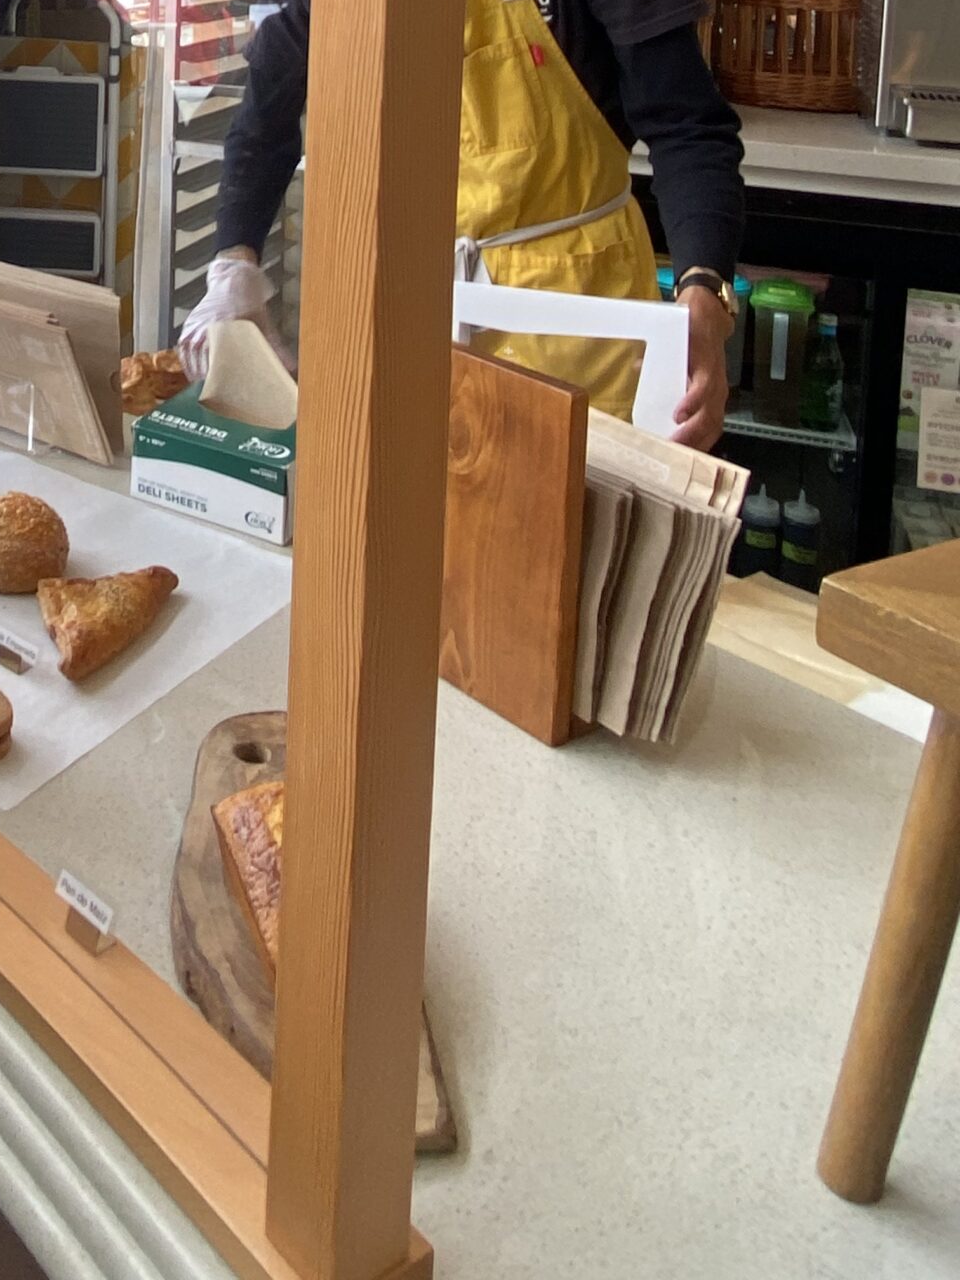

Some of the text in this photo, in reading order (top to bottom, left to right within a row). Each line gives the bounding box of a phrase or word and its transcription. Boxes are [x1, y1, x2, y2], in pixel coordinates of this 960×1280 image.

[906, 334, 953, 349] CLOVER
[151, 410, 229, 439] DELI SHEETS
[137, 483, 162, 499] DELI
[164, 491, 208, 513] SHEETS
